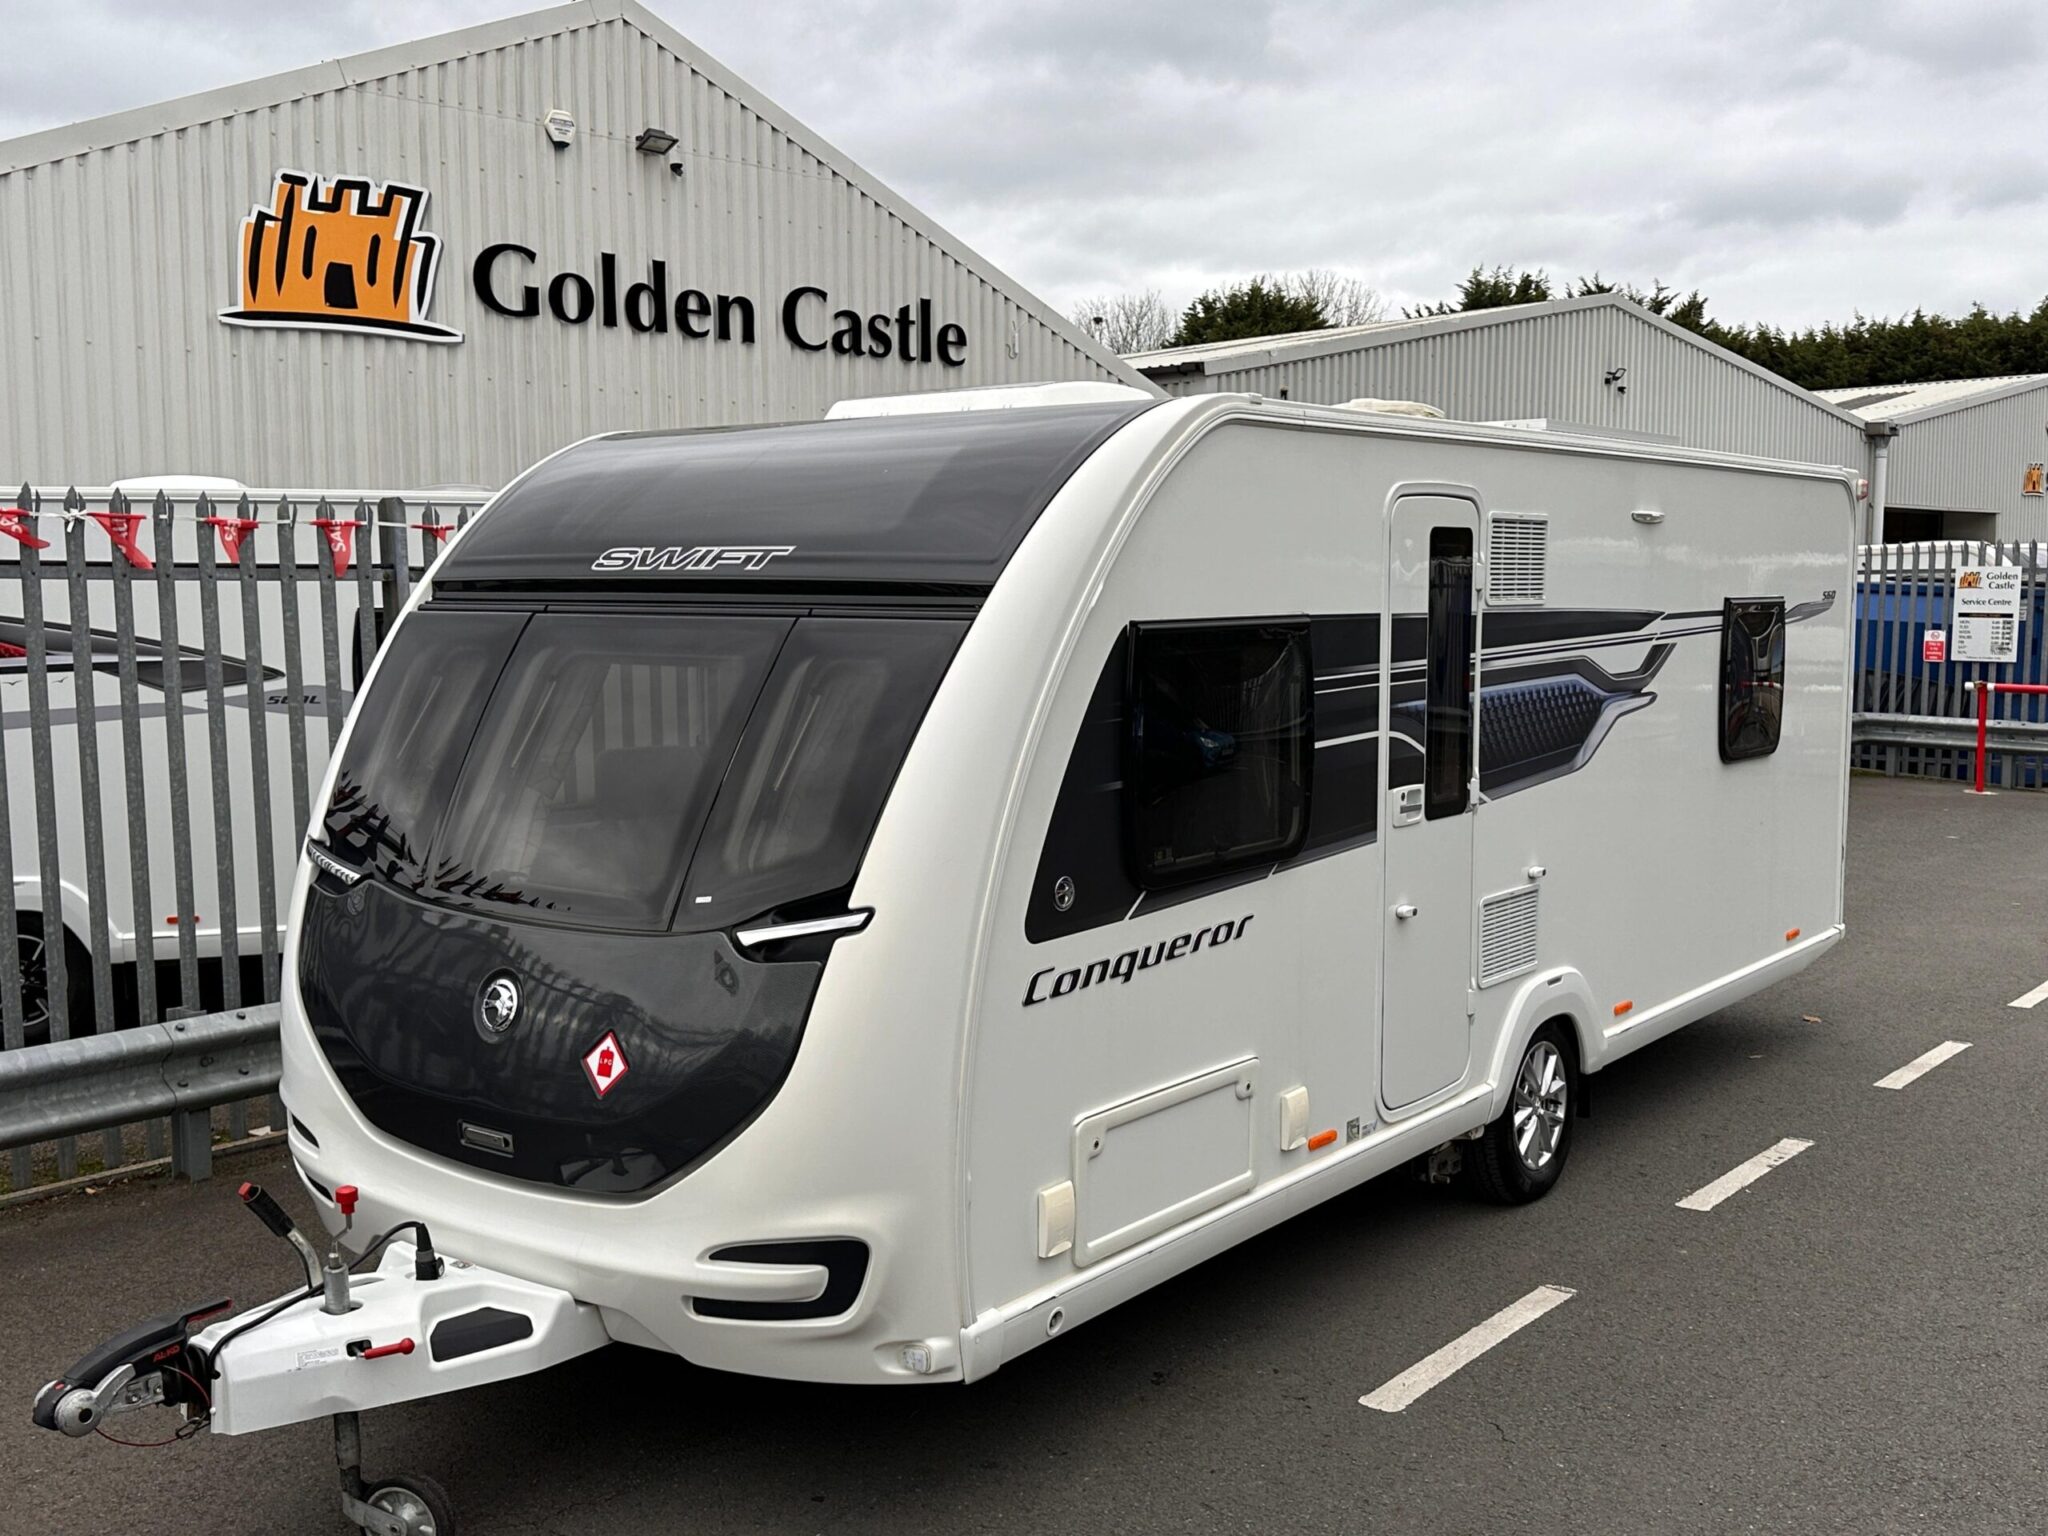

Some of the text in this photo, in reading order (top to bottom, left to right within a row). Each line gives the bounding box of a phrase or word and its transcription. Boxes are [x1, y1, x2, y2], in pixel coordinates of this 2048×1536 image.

[473, 243, 968, 367] Golden Castle
[591, 545, 797, 571] SWIFT
[1986, 572, 2018, 580] Golden
[1988, 582, 2015, 590] Castle
[1022, 914, 1255, 1007] Conqueror
[599, 1057, 613, 1066] LPG
